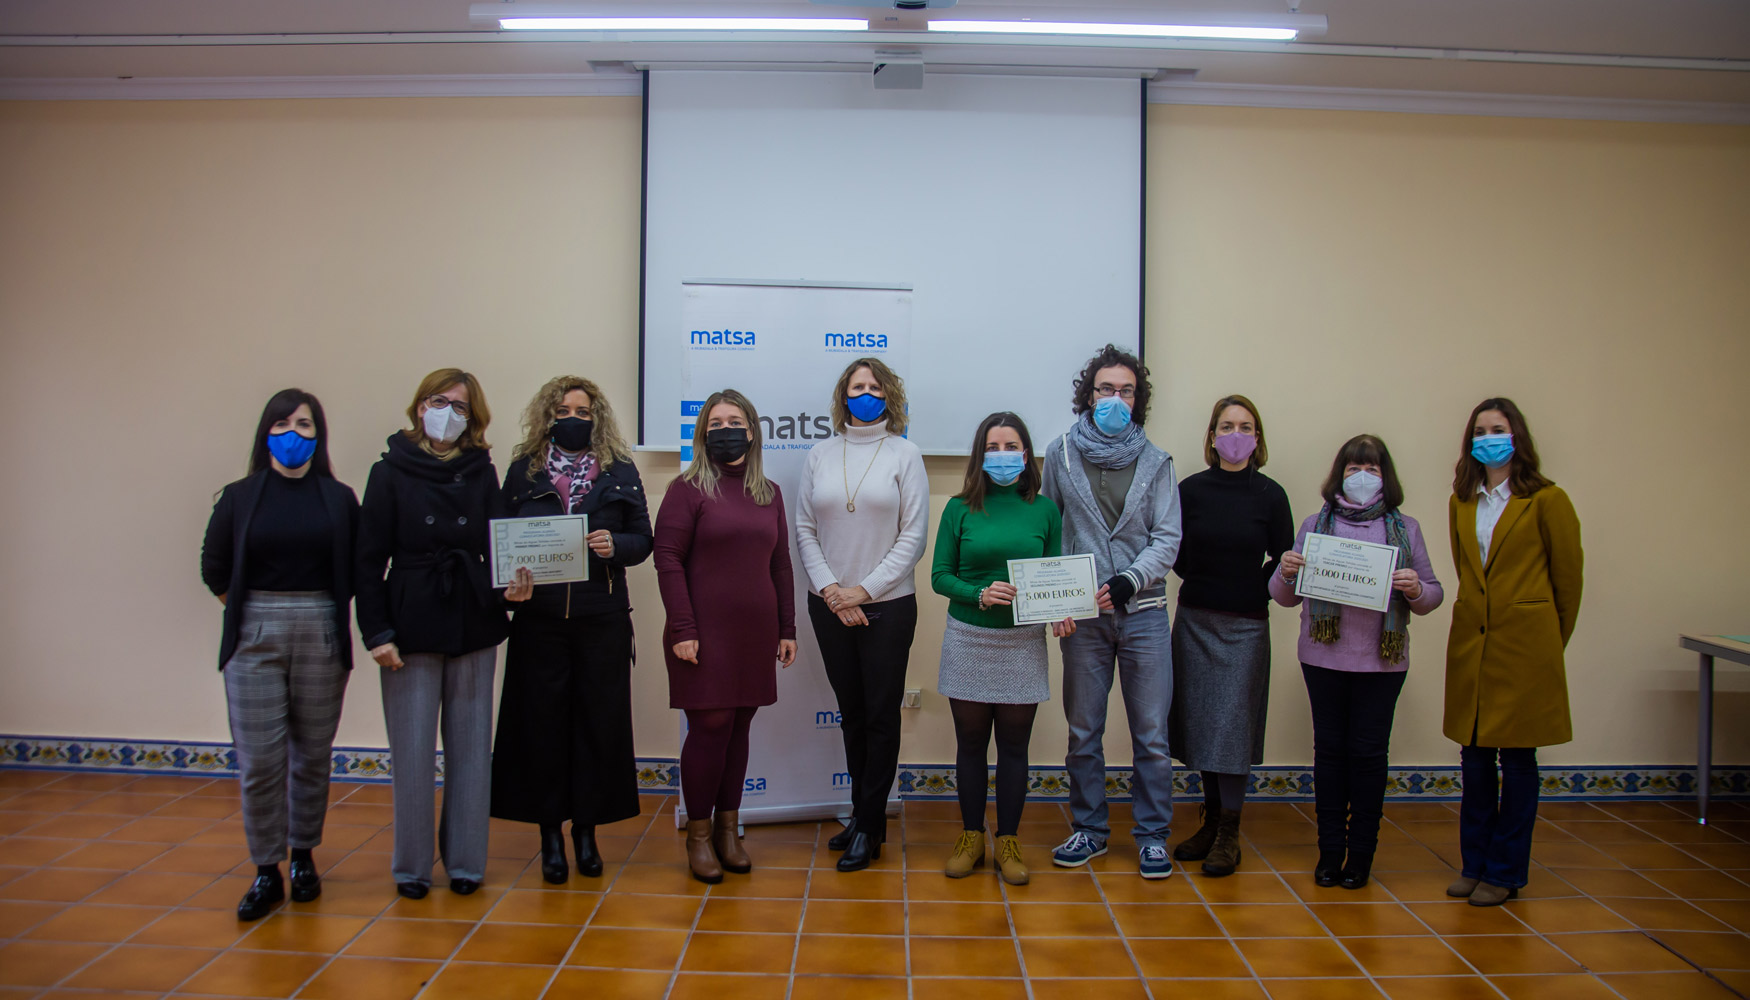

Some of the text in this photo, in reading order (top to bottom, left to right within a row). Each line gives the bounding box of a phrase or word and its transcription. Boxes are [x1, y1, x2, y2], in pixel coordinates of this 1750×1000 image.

[691, 329, 755, 345] matsa
[825, 332, 887, 347] matsa
[759, 412, 839, 440] ats
[1340, 542, 1362, 550] matsa
[508, 552, 574, 565] 7.000 EUROS
[1313, 566, 1340, 579] 3.000
[1341, 572, 1377, 586] EUROS
[1025, 587, 1086, 601] 5.000 EUROS
